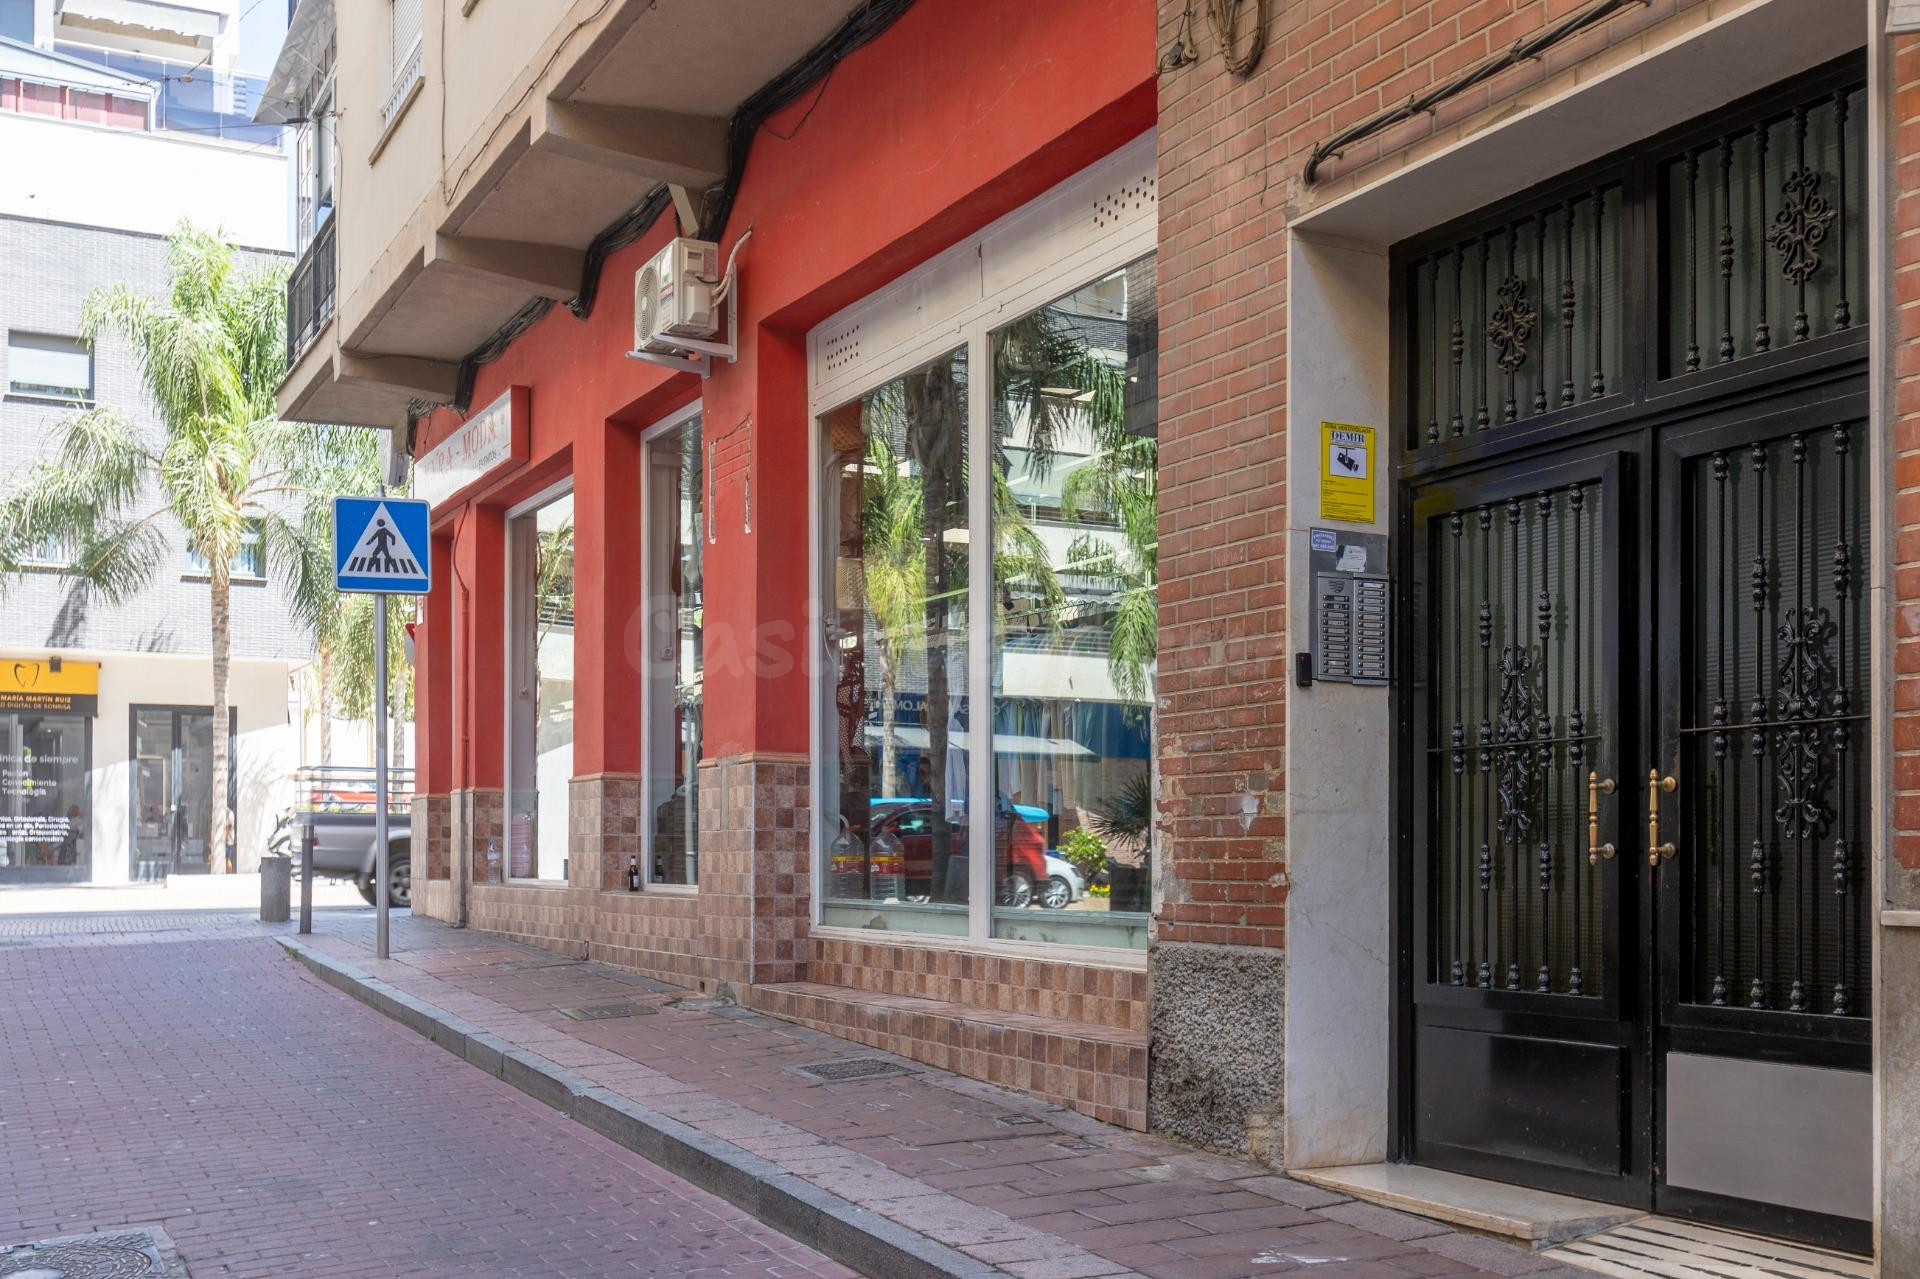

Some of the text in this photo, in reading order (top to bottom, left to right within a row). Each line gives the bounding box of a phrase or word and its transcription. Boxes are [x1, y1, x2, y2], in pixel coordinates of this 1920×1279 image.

[1331, 431, 1365, 442] DEMIR
[0, 694, 71, 704] MARÍA MARTÍN RUIZ
[39, 753, 79, 766] siempre
[2, 778, 57, 787] Conocimiento
[2, 787, 47, 797] Tecnología
